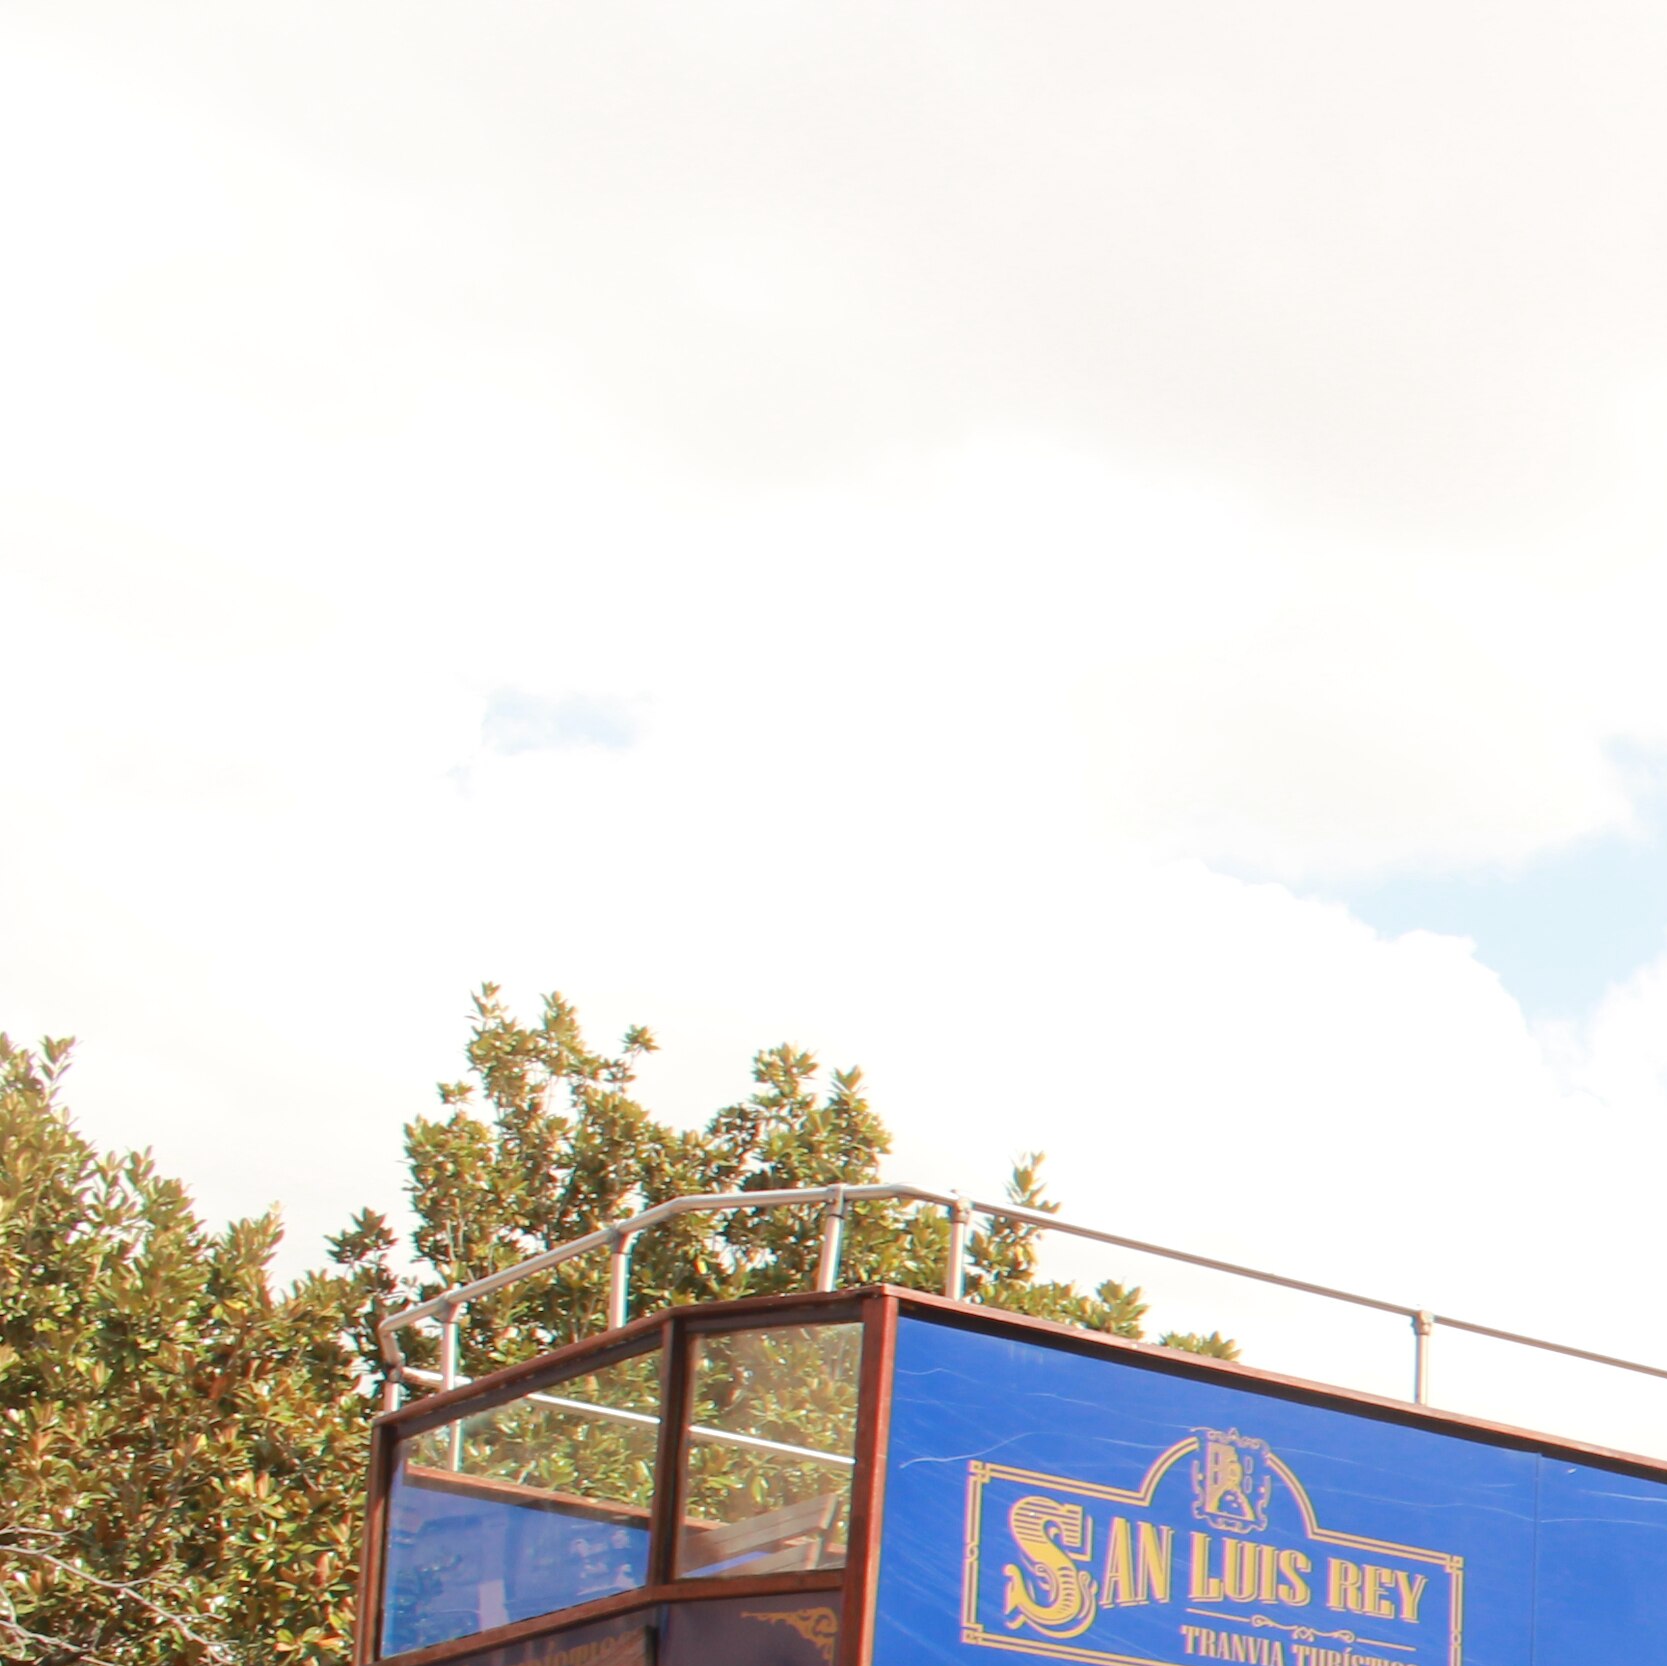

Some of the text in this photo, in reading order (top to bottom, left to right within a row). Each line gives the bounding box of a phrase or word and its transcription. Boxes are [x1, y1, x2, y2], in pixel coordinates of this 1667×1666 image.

[1004, 1496, 1429, 1638] SAN LUIS REY
